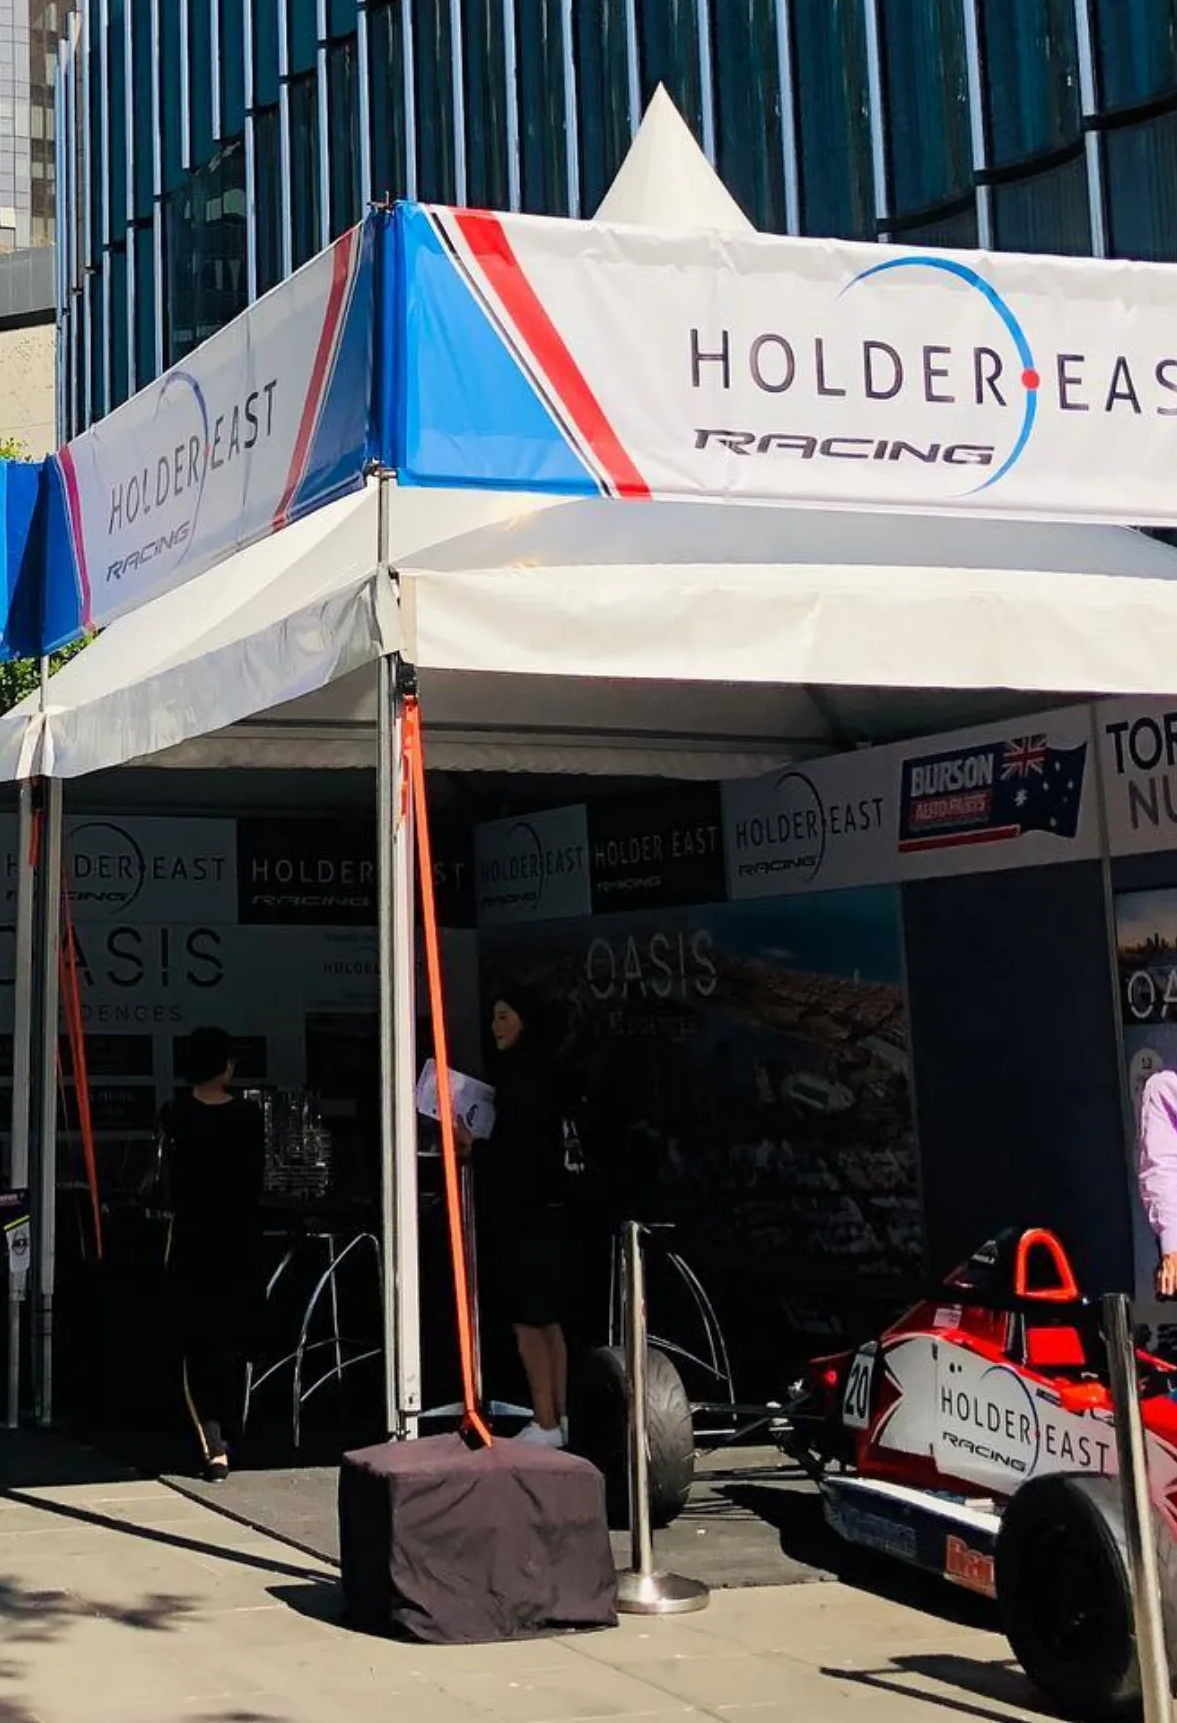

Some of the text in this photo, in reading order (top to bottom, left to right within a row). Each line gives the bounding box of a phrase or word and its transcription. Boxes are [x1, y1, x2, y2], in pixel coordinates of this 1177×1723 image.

[690, 328, 1007, 407] HOLDER
[107, 378, 279, 536] HOLDER EAST
[693, 428, 996, 466] RACING
[105, 520, 191, 583] RACING
[910, 752, 995, 797] BURSON
[735, 809, 818, 851] HOLDER
[829, 797, 883, 835] EAST
[7, 854, 226, 881] HDER EAST
[480, 846, 583, 882] HOLDER EAST
[594, 825, 720, 869] HOLDER EAST
[737, 856, 817, 877] RACING
[251, 856, 375, 884] HOLDER
[586, 928, 718, 1001] OASIS
[845, 1362, 869, 1420] 20
[940, 1385, 1111, 1476] HOLDER EAST
[942, 1431, 1027, 1473] RACING
